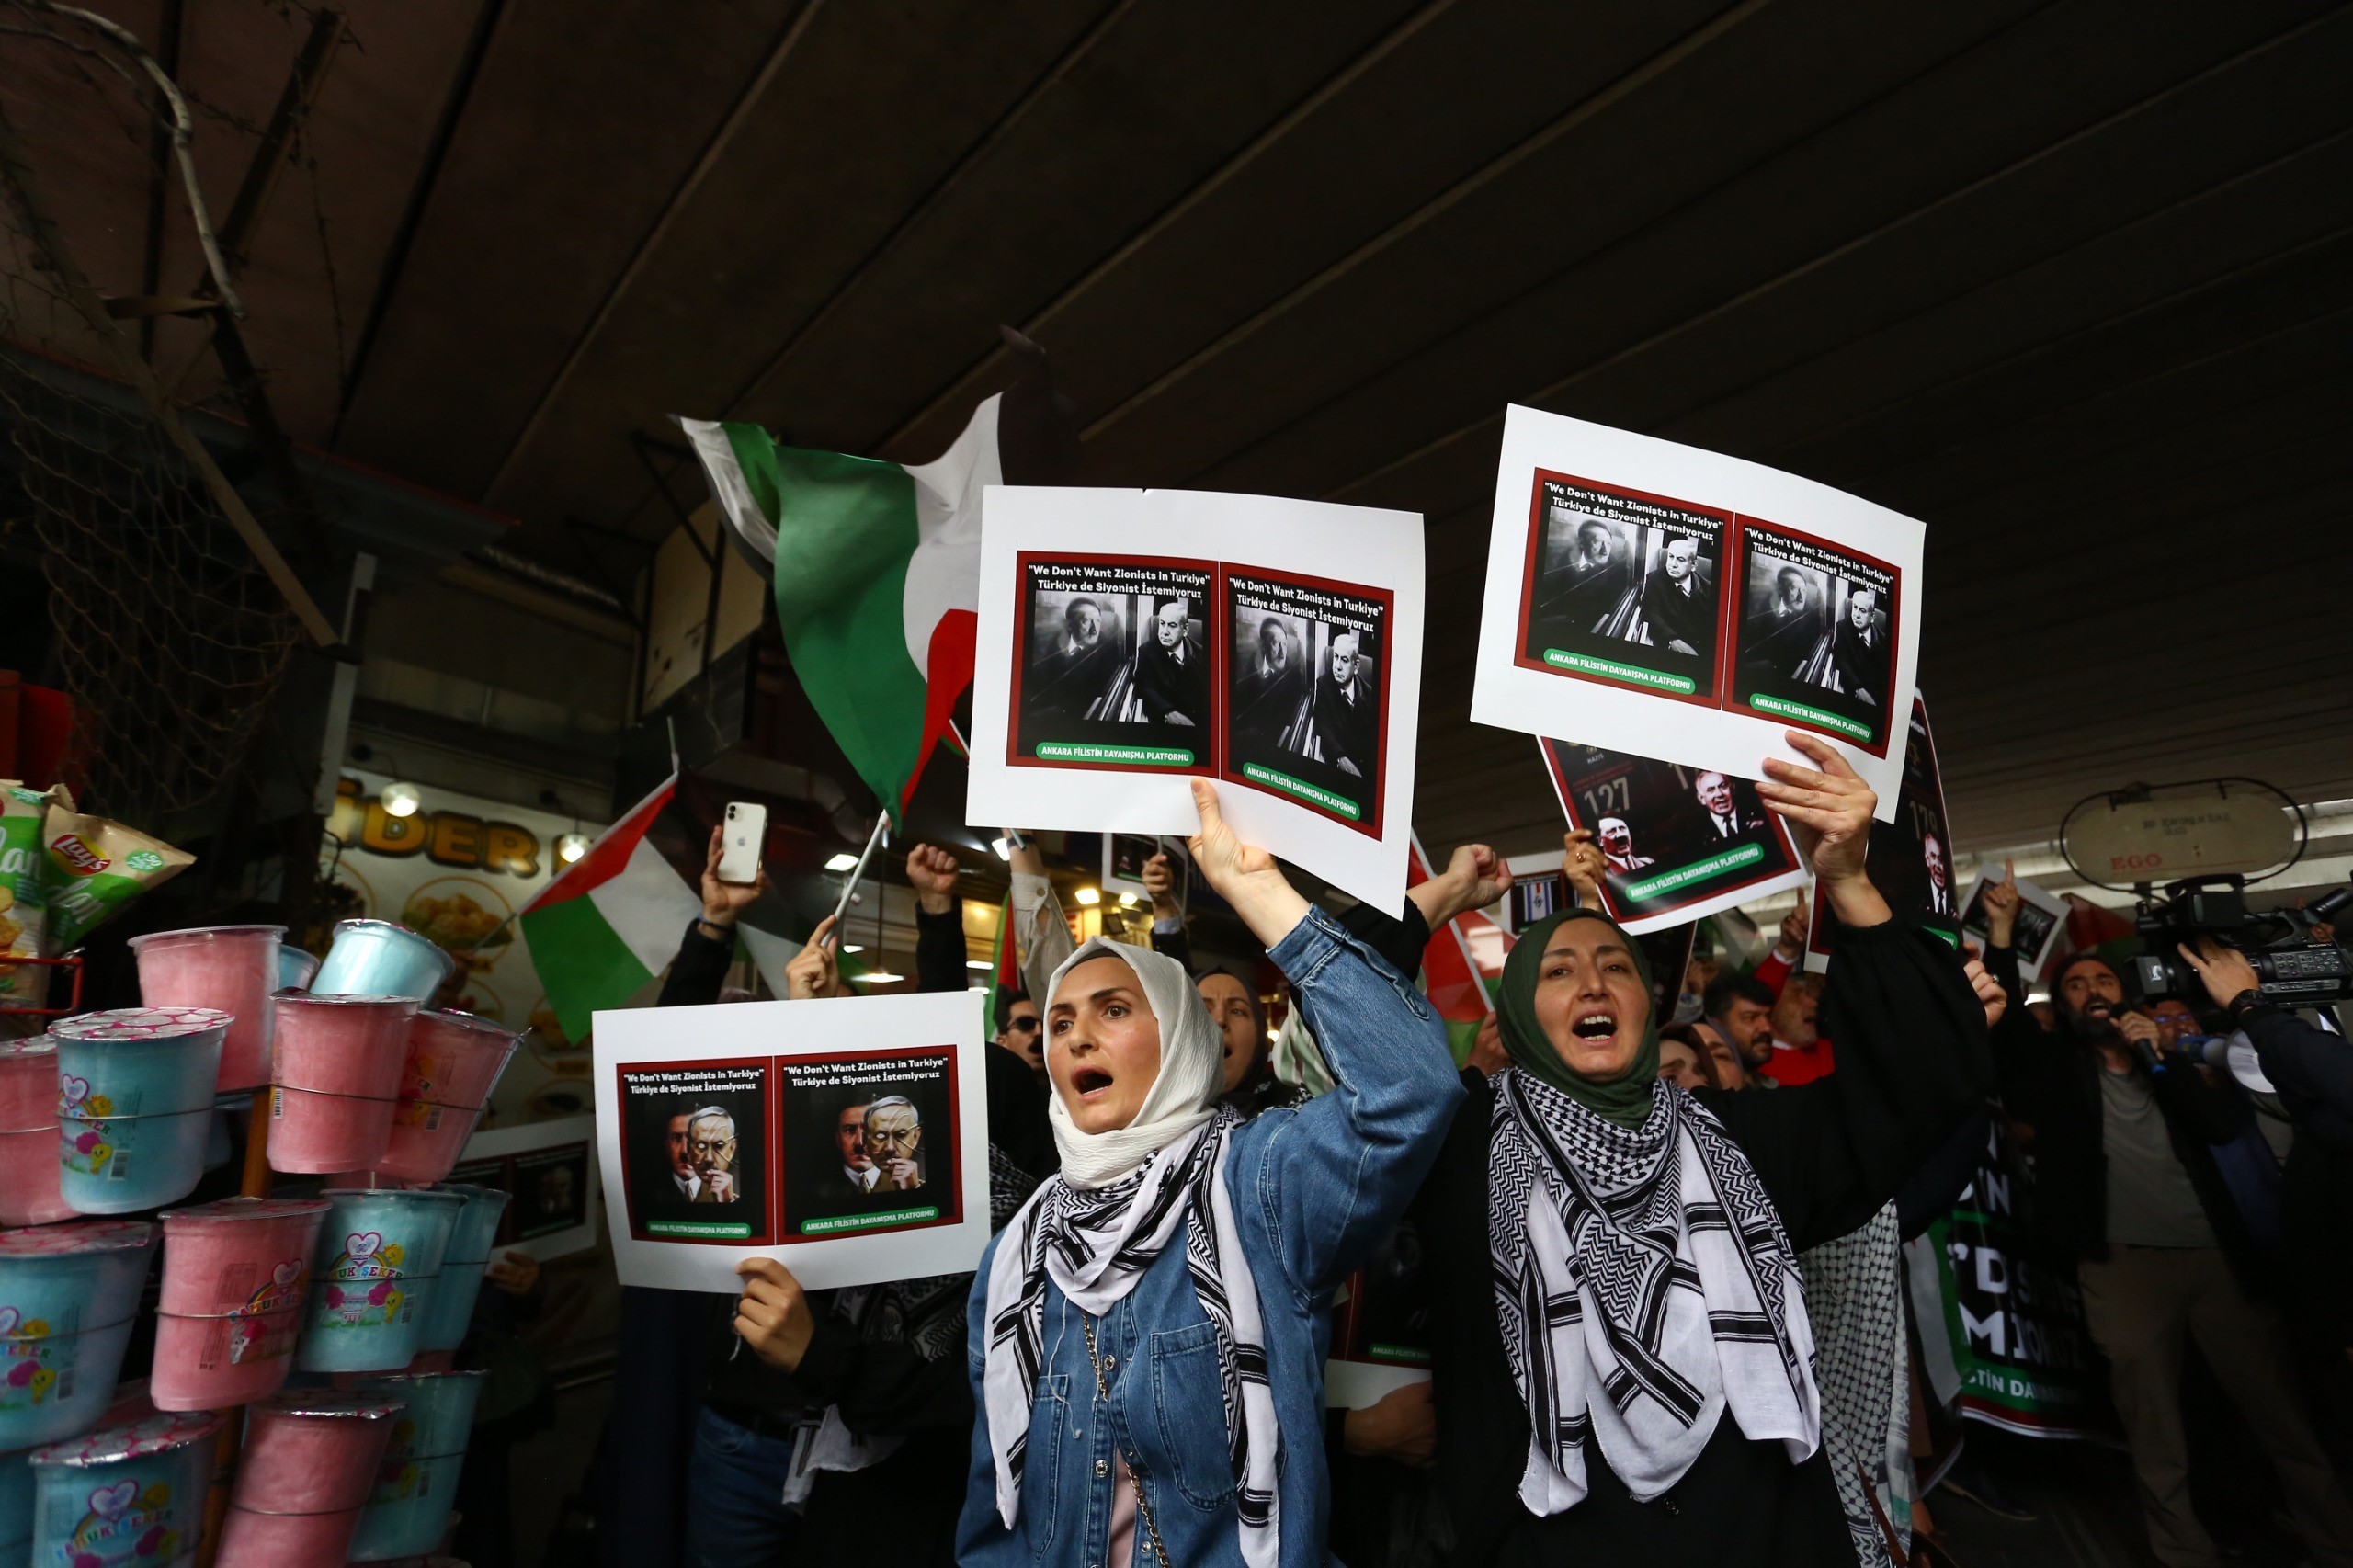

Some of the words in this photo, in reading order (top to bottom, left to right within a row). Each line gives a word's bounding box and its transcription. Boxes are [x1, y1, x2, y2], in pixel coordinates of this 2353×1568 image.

[1544, 482, 1564, 494] "We
[1567, 487, 1595, 501] Don't
[1597, 494, 1624, 507] Want
[1626, 500, 1667, 517] Zionists
[1670, 510, 1679, 519] in
[1681, 512, 1724, 529] Turkiye"
[1552, 496, 1591, 513] Türkiye
[1593, 506, 1606, 516] de
[1608, 508, 1650, 526] Siyonist
[1652, 517, 1713, 540] İstemiyoruz
[1753, 542, 1787, 560] Türkiye
[1789, 553, 1801, 563] de
[1802, 557, 1837, 575] Siyonist
[1839, 566, 1887, 594] İstemiyoruz
[1766, 533, 1790, 548] Don't
[1792, 540, 1815, 555] Want
[1817, 550, 1851, 567] Zionists
[1852, 561, 1860, 571] in
[1029, 564, 1050, 574] "We
[1051, 565, 1081, 576] Don't
[1084, 567, 1111, 577] Want
[1114, 568, 1156, 580] Zionists
[1158, 571, 1168, 581] in
[1170, 572, 1211, 586] Turkiye"
[1038, 579, 1077, 592] Türkiye
[1080, 581, 1093, 591] de
[1096, 582, 1139, 594] Siyonist
[1142, 582, 1202, 598] İstemiyoruz
[1229, 577, 1246, 589] "We
[1247, 581, 1270, 594] Don't
[1272, 585, 1294, 598] Want
[1296, 589, 1331, 606] Zionists
[1333, 597, 1342, 608] in
[1344, 598, 1383, 618] Turkiye"
[1237, 594, 1268, 609] Türkiye
[1269, 600, 1280, 611] de
[1282, 602, 1317, 619] Siyonist
[1319, 607, 1374, 632] İstemiyoruz
[1550, 653, 1578, 665] ANKARA
[1580, 658, 1608, 672] FİLİSTİN
[1609, 665, 1648, 681] DAYANIŞMA
[1650, 675, 1691, 690] PLATFORMU
[1755, 698, 1782, 710] ANKARA
[1783, 703, 1808, 717] FİLİSTİN
[1809, 710, 1841, 727] DAYANIŞMA
[1842, 722, 1870, 738] PLATFORMU
[1041, 746, 1072, 756] ANKARA
[1074, 746, 1102, 756] FİLİSTİN
[1104, 749, 1145, 760] DAYANIŞMA
[1146, 751, 1189, 761] PLATFORMU
[1247, 767, 1269, 781] ANKARA
[1270, 773, 1291, 789] FİLİSTİN
[1292, 782, 1323, 801] DAYANIŞMA
[1324, 795, 1357, 815] PLATFORMU
[1584, 777, 1630, 817] 127
[2111, 853, 2162, 869] EGO
[639, 1073, 660, 1082] Don't
[661, 1072, 682, 1081] Want
[683, 1071, 716, 1080] Zionists
[717, 1071, 726, 1079] in
[783, 1066, 801, 1074] "We
[803, 1064, 829, 1074] Don't
[830, 1063, 856, 1073] Want
[858, 1062, 895, 1071] Zionists
[897, 1060, 907, 1069] in
[908, 1057, 949, 1068] Turkiye"
[791, 1077, 826, 1087] Türkiye
[828, 1076, 840, 1085] de
[842, 1074, 881, 1085] Siyonist
[882, 1071, 940, 1082] İstemiyoruz
[631, 1085, 658, 1096] Türkiye
[659, 1085, 669, 1093] de
[670, 1084, 703, 1095] Siyonist
[704, 1081, 756, 1092] İstemiyoruz
[805, 1221, 833, 1231] ANKARA
[834, 1218, 859, 1228] FİLİSTİN
[860, 1214, 897, 1225] DAYANIŞMA
[898, 1210, 935, 1221] PLATFORMU
